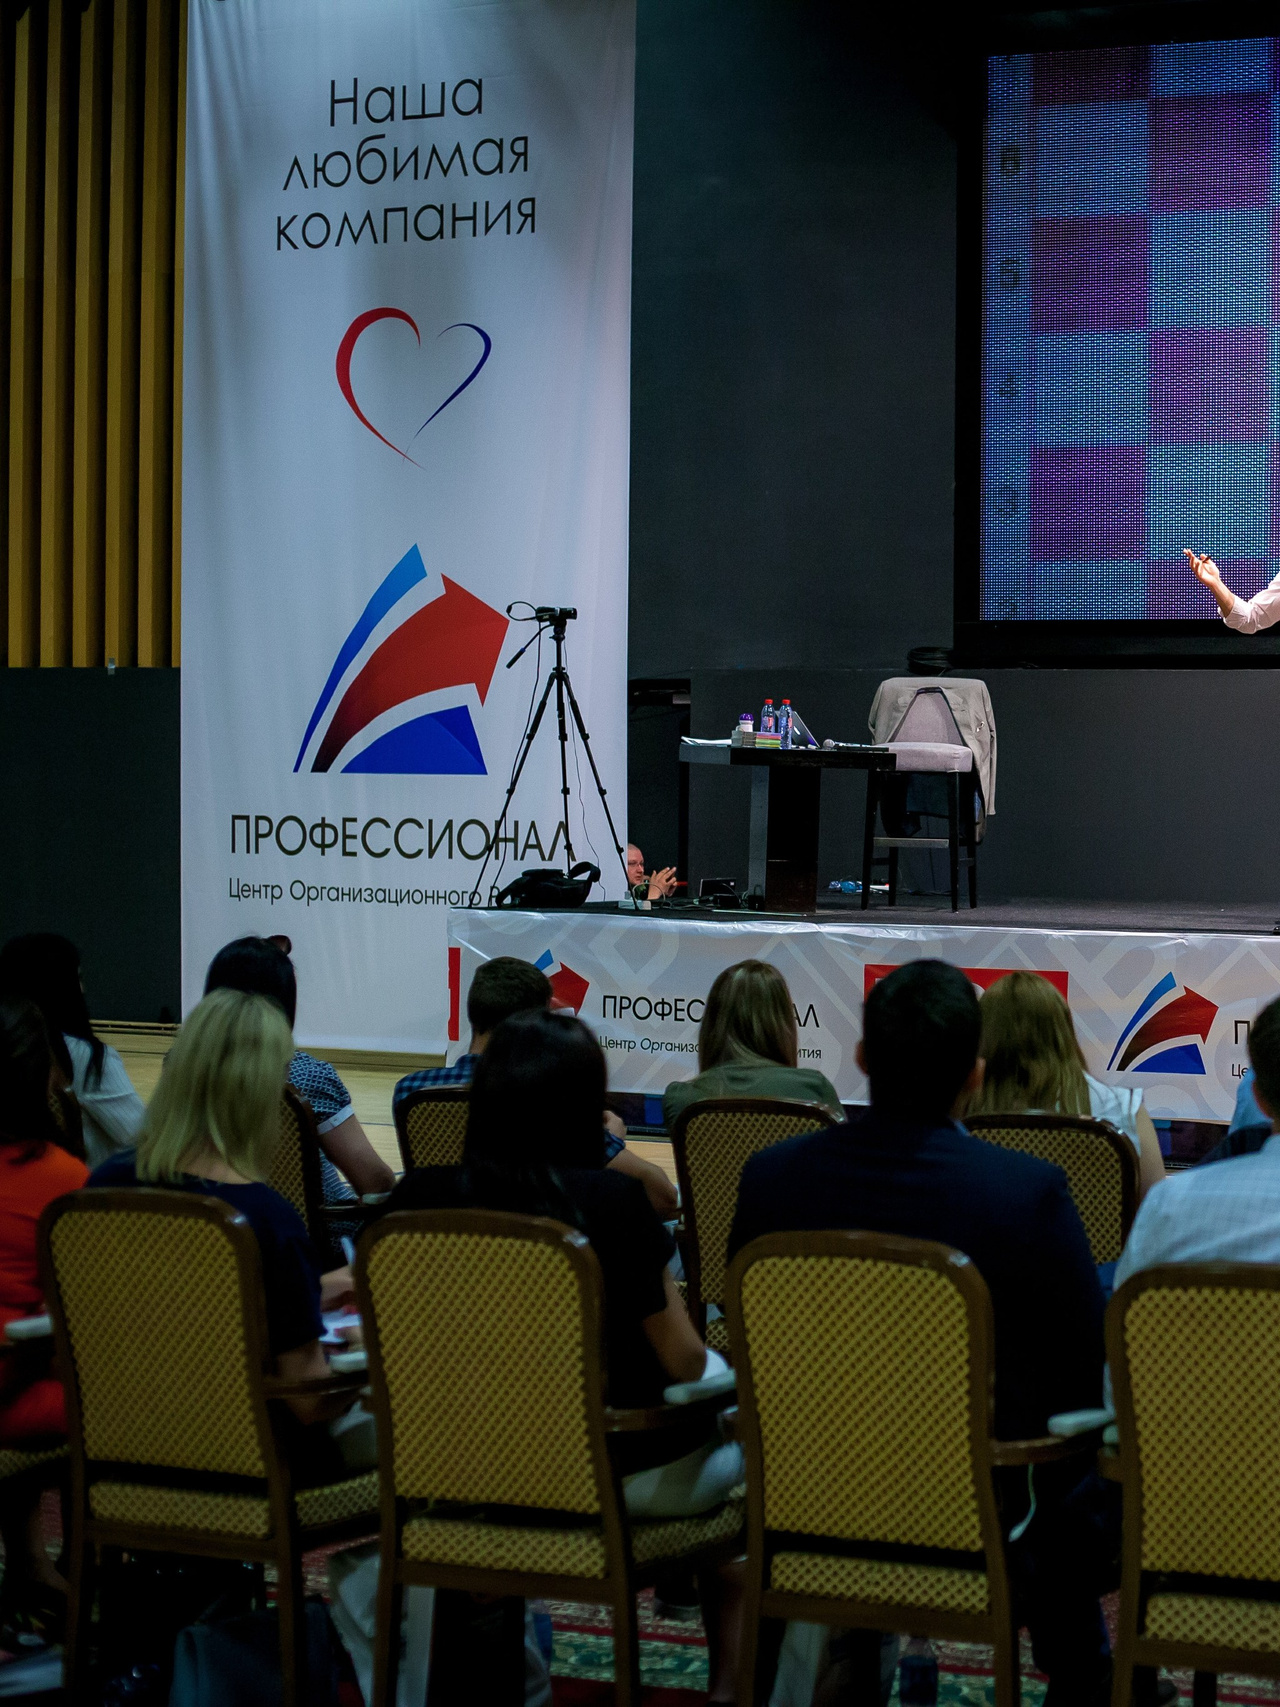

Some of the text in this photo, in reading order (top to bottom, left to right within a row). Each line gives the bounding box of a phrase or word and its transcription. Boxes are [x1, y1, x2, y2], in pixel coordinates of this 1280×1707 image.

[329, 77, 484, 127] Наша
[283, 133, 529, 190] любимая
[276, 197, 537, 251] компания
[230, 814, 577, 862] ПРОФЕССИОНАЛ
[229, 877, 283, 905] Центр
[290, 879, 482, 907] Организационного
[599, 1035, 636, 1052] Центр
